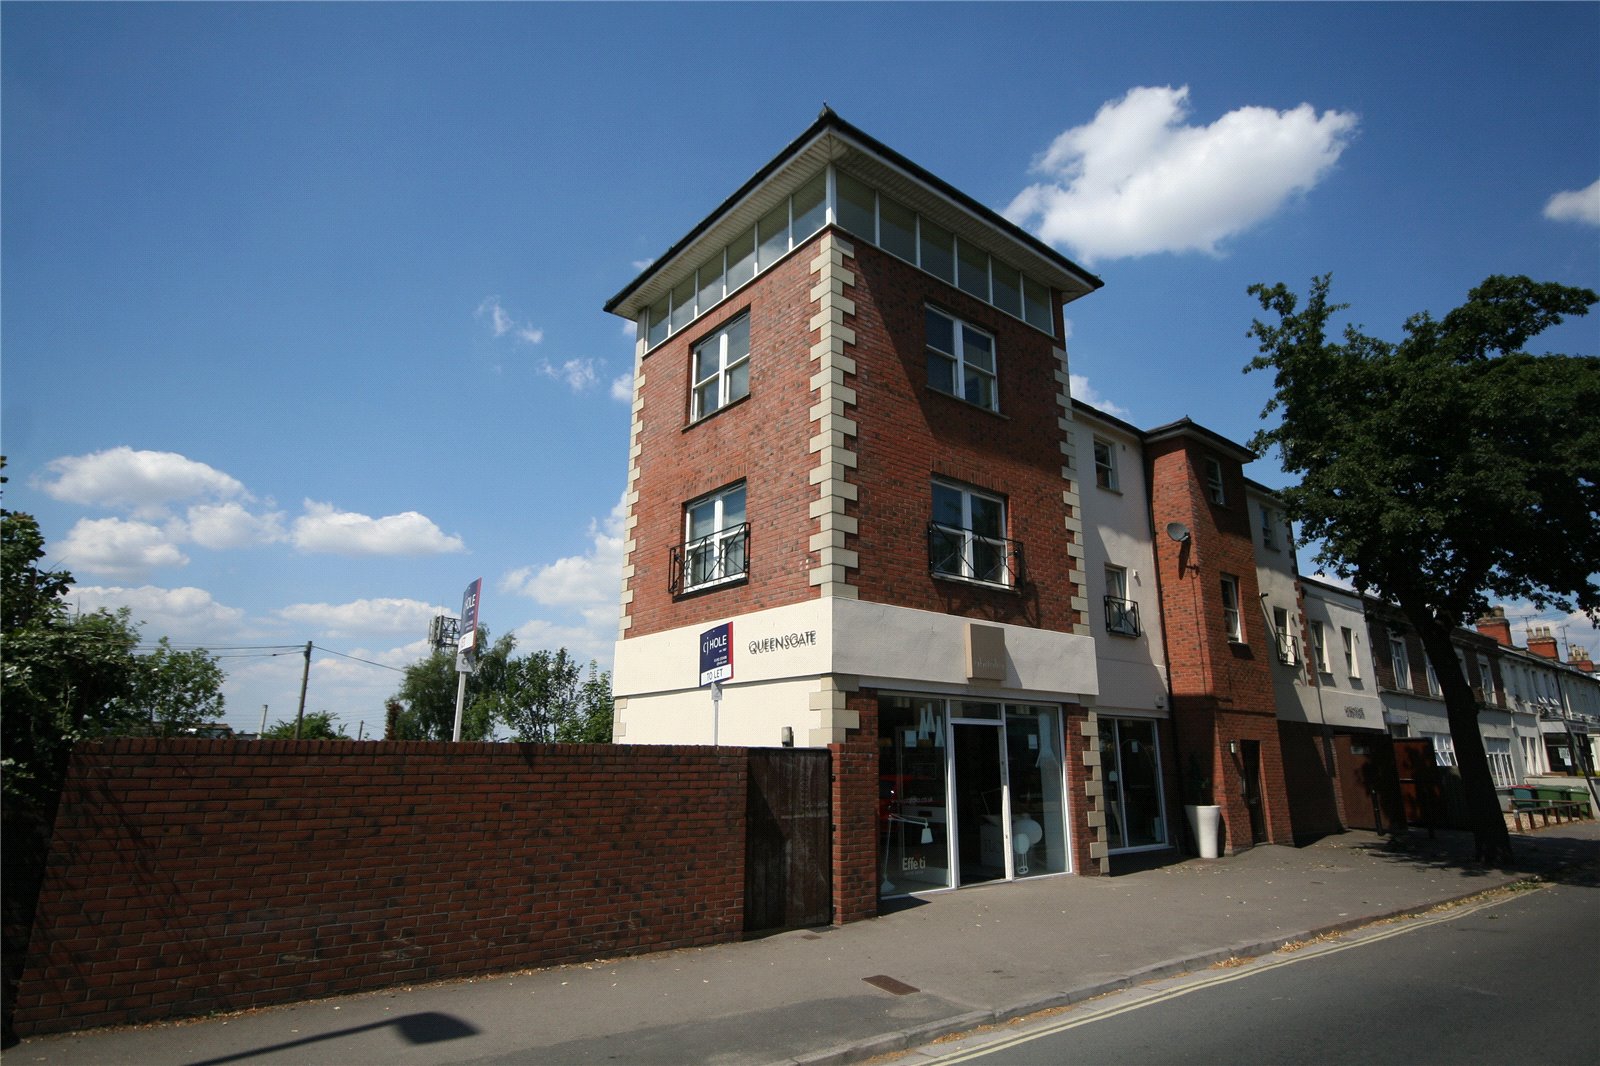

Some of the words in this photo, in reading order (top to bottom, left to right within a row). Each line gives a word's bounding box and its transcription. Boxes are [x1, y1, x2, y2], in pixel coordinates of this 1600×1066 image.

[710, 634, 728, 650] HOLE
[749, 630, 816, 655] QUEENSGATE
[706, 671, 713, 681] TO
[714, 668, 723, 679] LET
